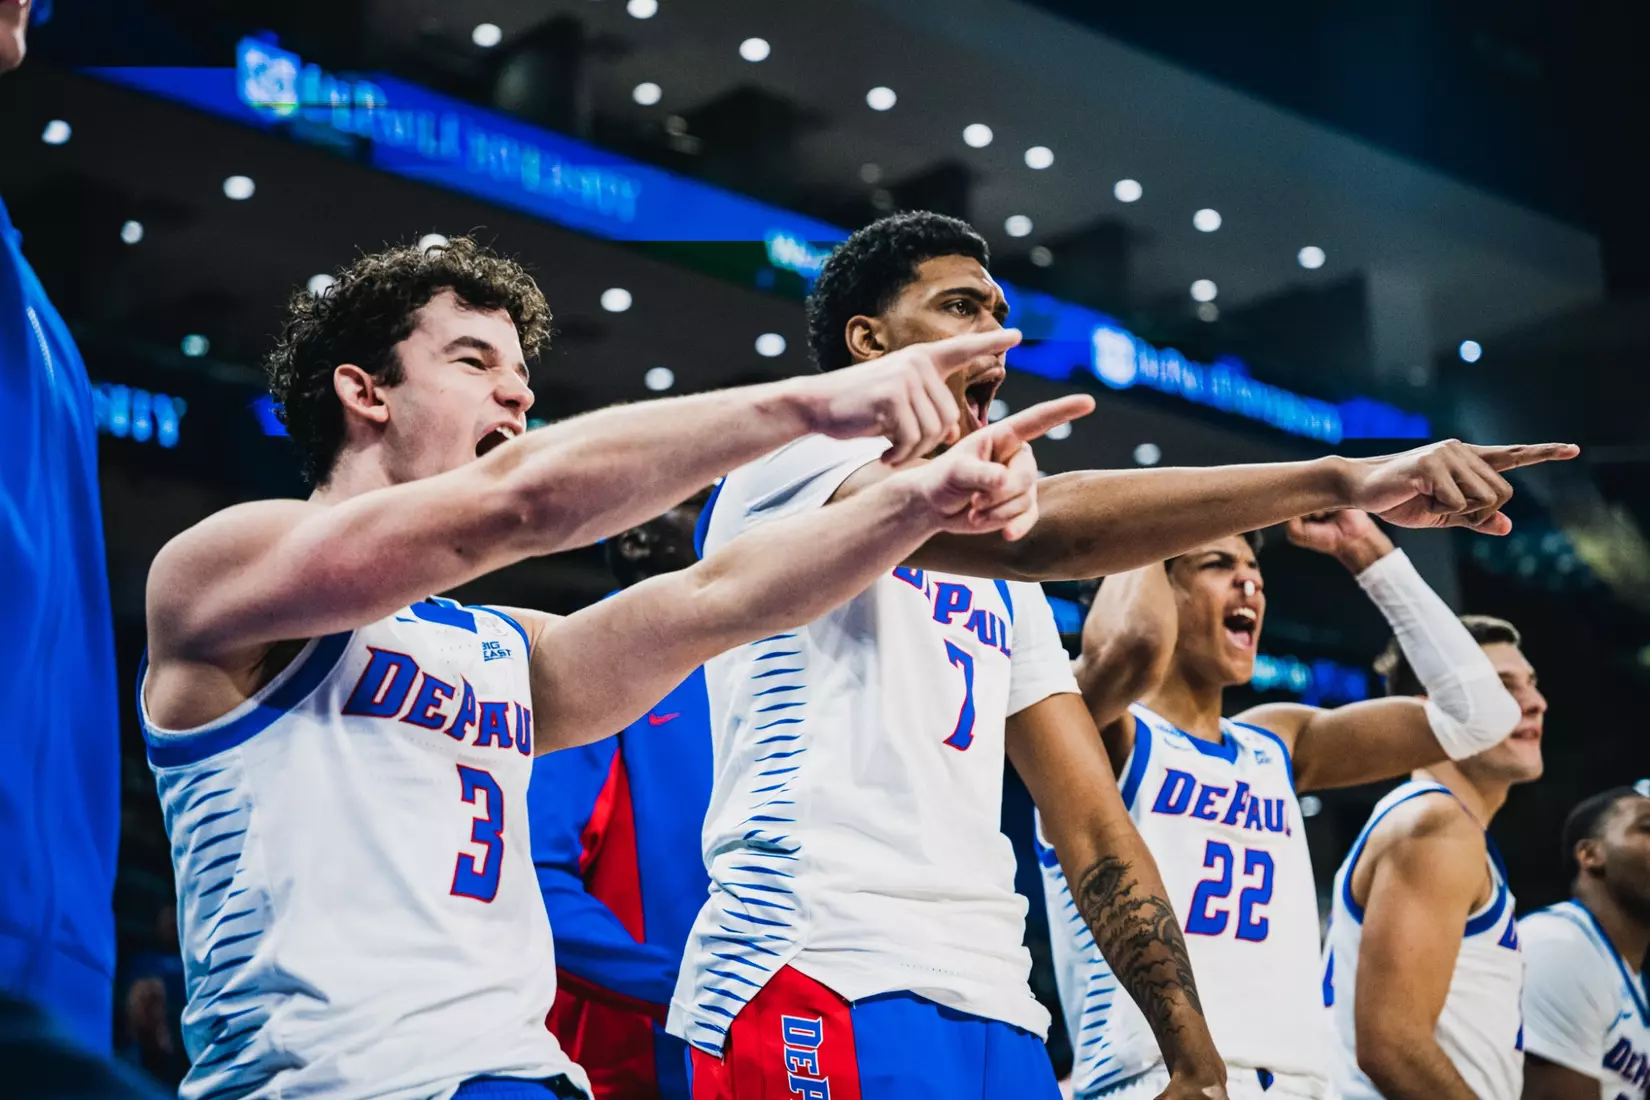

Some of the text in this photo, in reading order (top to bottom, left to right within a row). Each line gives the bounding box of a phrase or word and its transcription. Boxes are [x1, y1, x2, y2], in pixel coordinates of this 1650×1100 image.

[943, 637, 975, 751] 7
[450, 764, 504, 903] 3
[1184, 840, 1274, 942] 22
